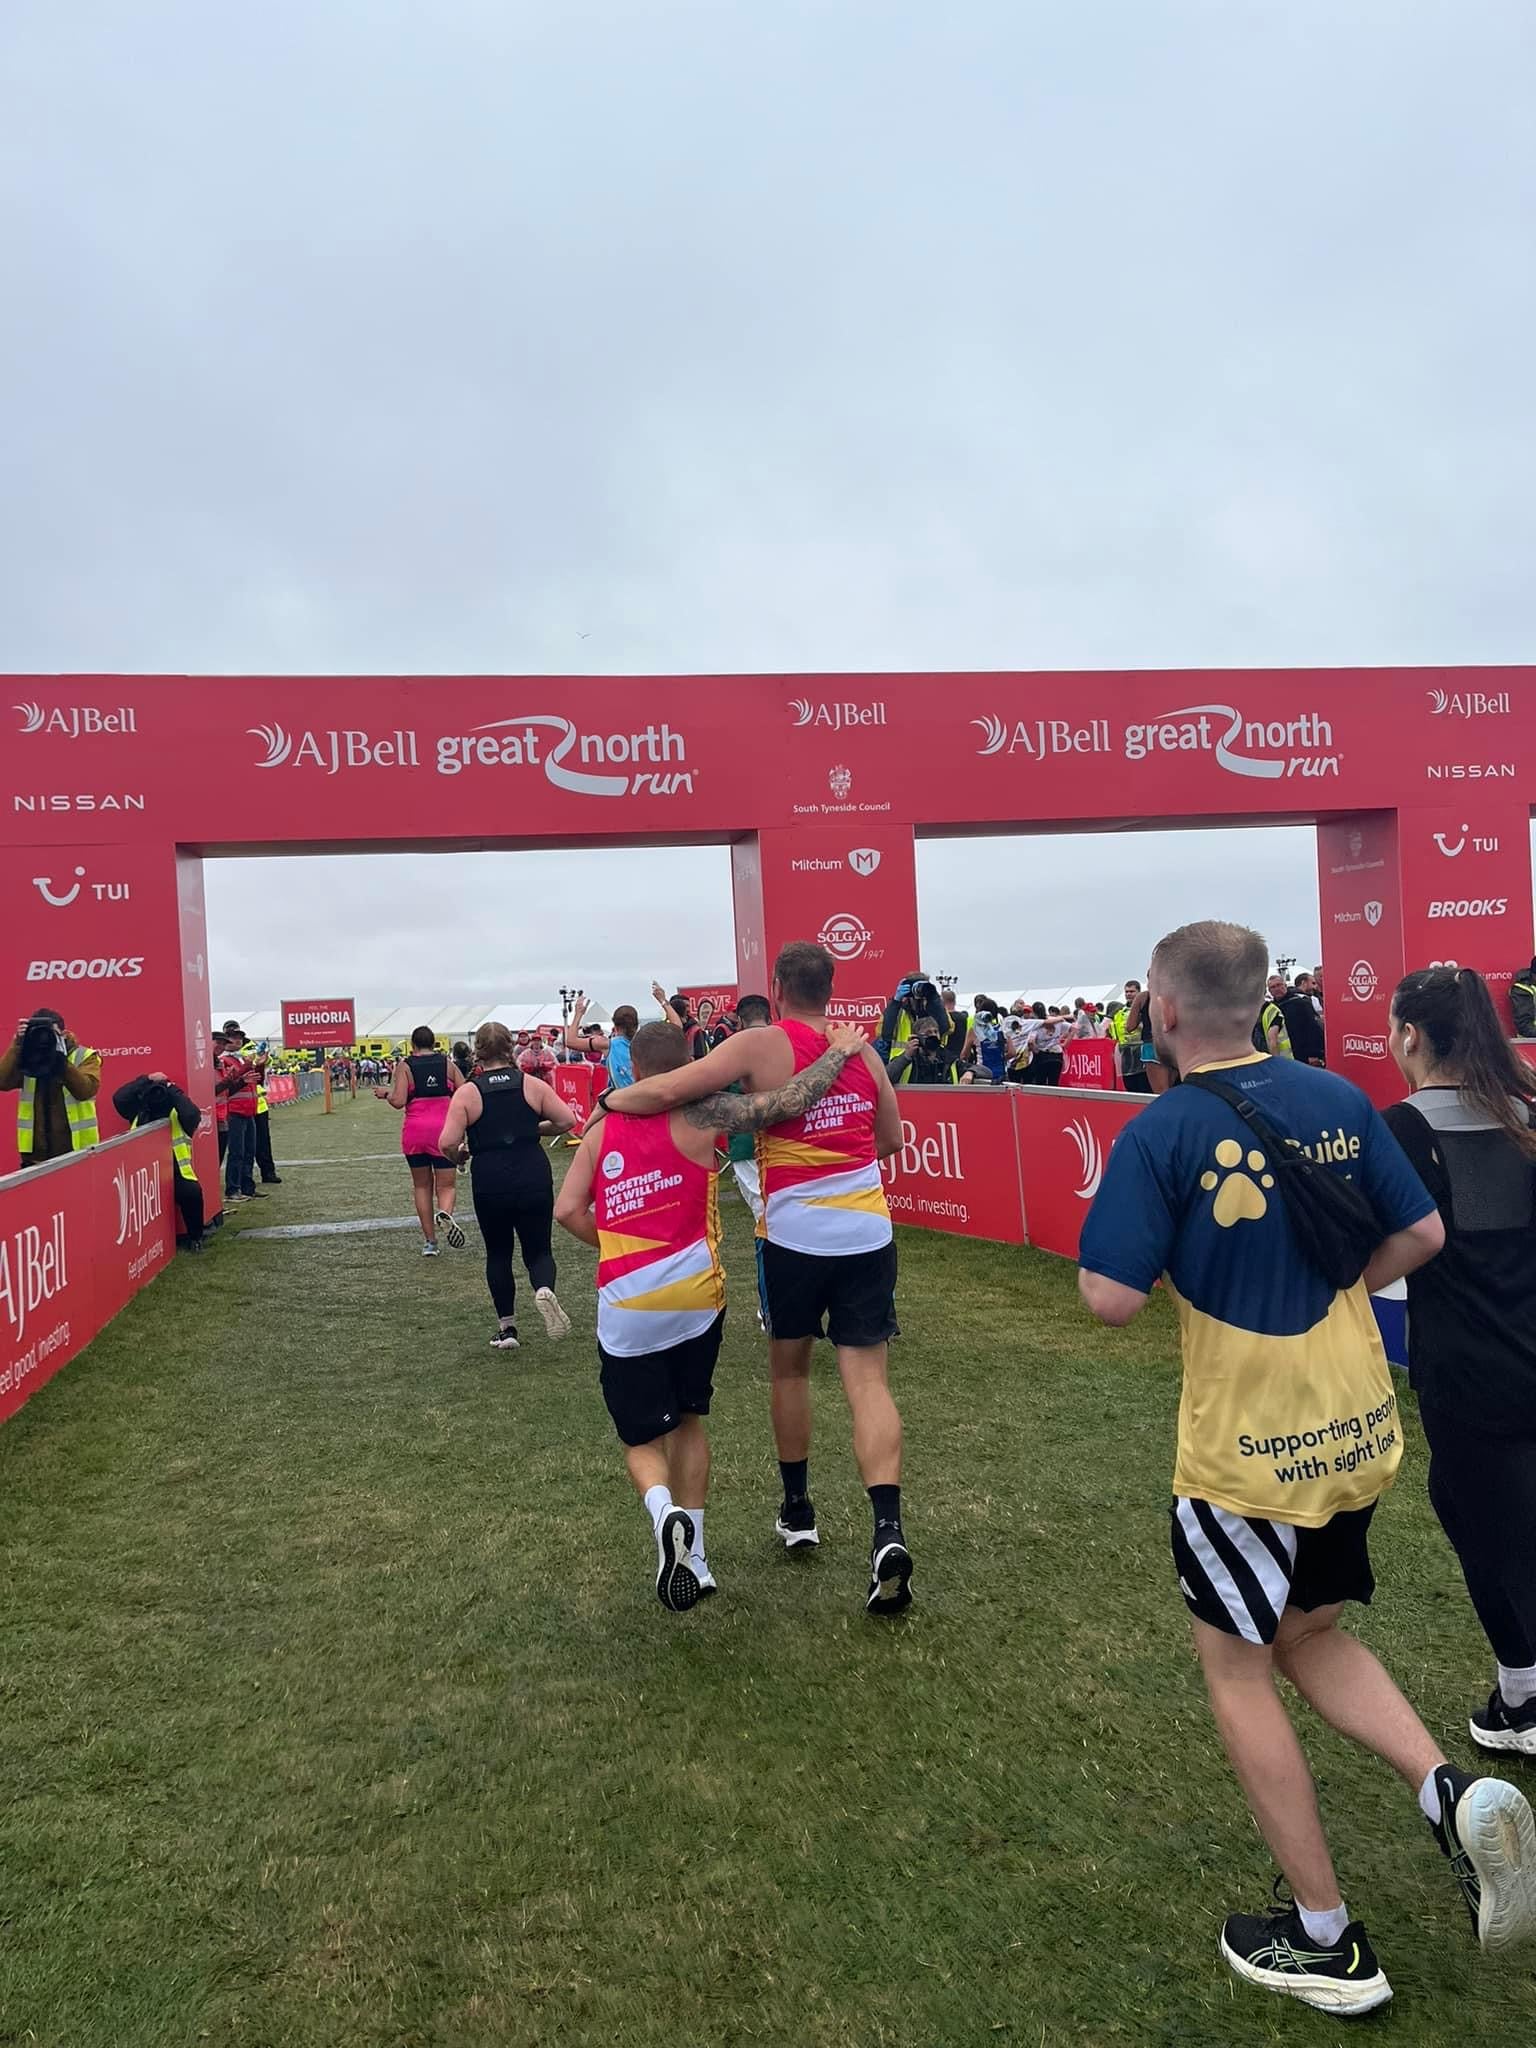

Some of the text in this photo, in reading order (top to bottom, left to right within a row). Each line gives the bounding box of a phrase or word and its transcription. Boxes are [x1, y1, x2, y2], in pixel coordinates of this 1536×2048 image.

[1125, 712, 1332, 760] great north
[436, 724, 686, 775] great north
[1287, 754, 1340, 777] run
[1427, 763, 1515, 779] NISSAN
[631, 770, 695, 796] run
[14, 794, 145, 812] NISSAN
[793, 802, 891, 814] South Tyneside Council
[1472, 837, 1499, 852] TUI
[791, 858, 842, 871] Mitchum
[91, 883, 130, 900] TUI
[1428, 898, 1508, 919] BROOKS
[816, 930, 872, 944] SOLGAR
[863, 949, 885, 960] 1947
[26, 957, 145, 981] BROOKS
[1347, 975, 1378, 986] SOLGAR
[287, 1010, 351, 1025] EUPHORIA
[825, 1003, 882, 1018] UA PURA
[91, 1046, 152, 1057] nsurance
[811, 1092, 860, 1109] OGETHER
[824, 1105, 852, 1118] WILL
[803, 1122, 813, 1133] A
[814, 1116, 844, 1130] CURE
[879, 1120, 965, 1185] JBell
[604, 1169, 663, 1198] TOGETHER
[605, 1174, 684, 1209] WE WILL FIND
[605, 1208, 616, 1221] A
[615, 1198, 646, 1216] CURE
[918, 1195, 971, 1223] investing.
[0, 1361, 13, 1395] eel
[1238, 1416, 1363, 1460] Supporting
[1274, 1455, 1329, 1483] with
[1334, 1440, 1376, 1473] sight
